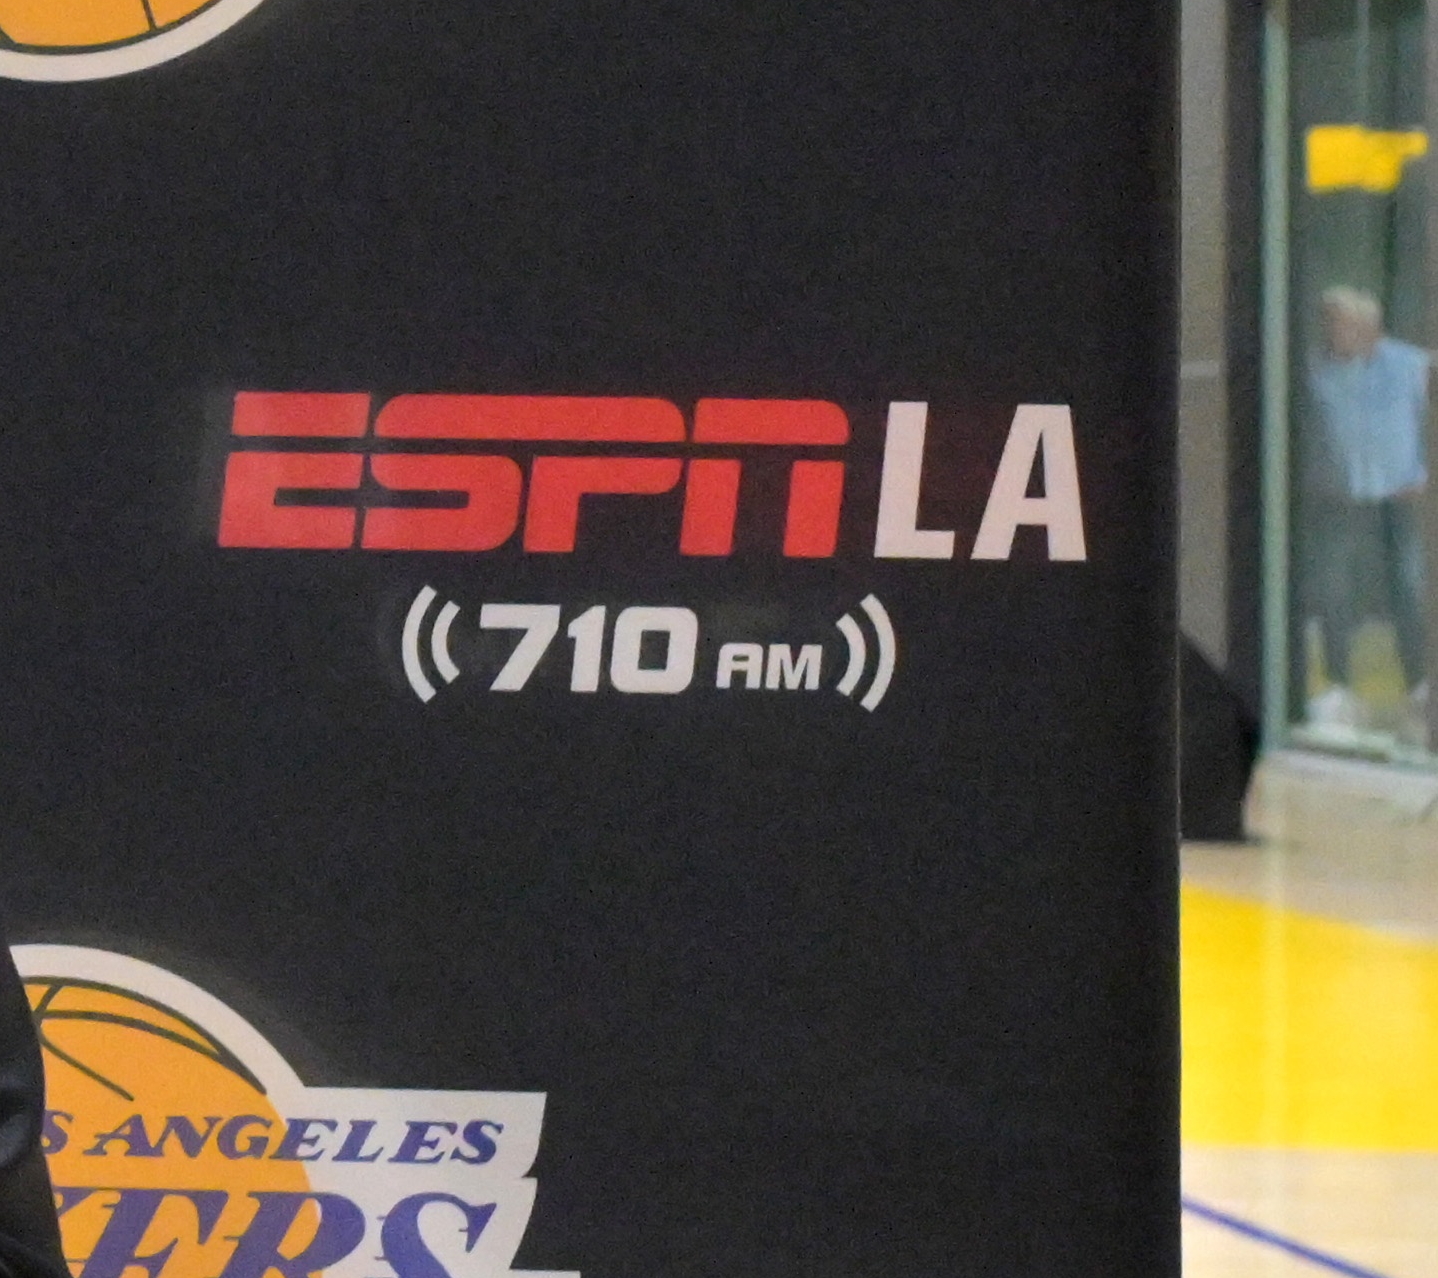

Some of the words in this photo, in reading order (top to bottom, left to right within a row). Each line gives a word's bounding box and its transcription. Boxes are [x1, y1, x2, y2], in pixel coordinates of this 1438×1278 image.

[217, 390, 850, 558] ESPN
[874, 401, 1088, 561] LA
[479, 603, 699, 694] 710
[716, 642, 823, 691] AM
[89, 1114, 505, 1164] ANGELES
